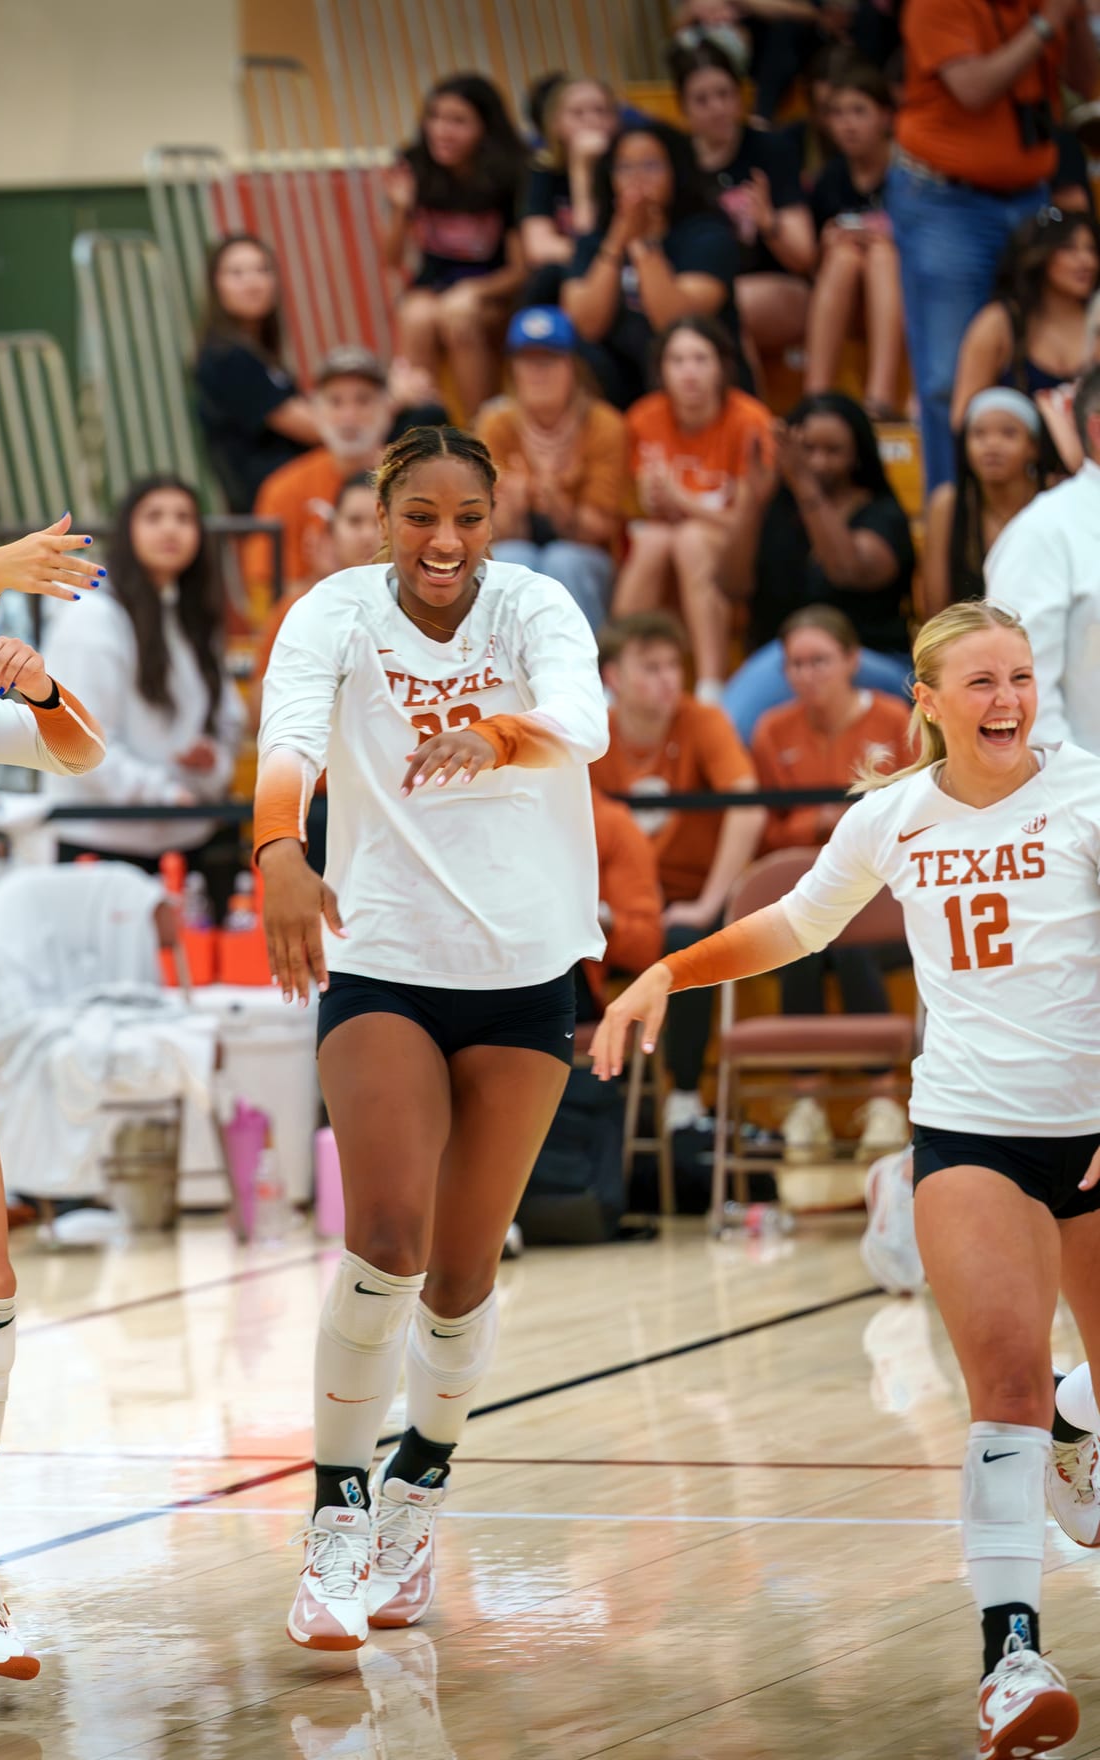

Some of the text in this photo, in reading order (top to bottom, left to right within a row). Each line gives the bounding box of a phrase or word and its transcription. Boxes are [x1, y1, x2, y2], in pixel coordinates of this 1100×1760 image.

[909, 841, 1047, 888] TEXAS
[943, 892, 1014, 971] 12
[335, 1514, 356, 1523] NIKE
